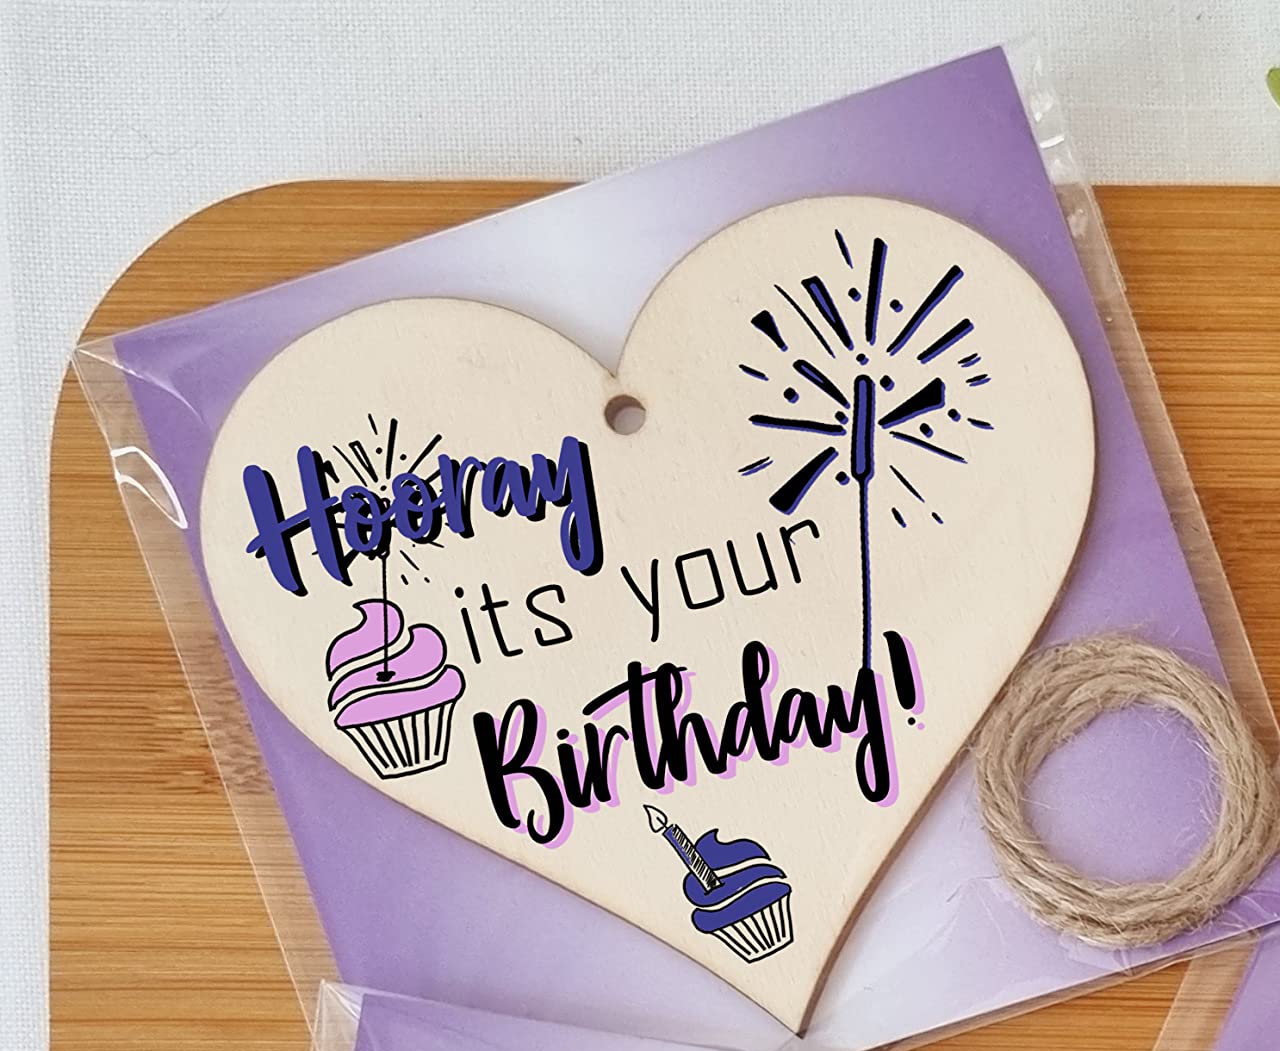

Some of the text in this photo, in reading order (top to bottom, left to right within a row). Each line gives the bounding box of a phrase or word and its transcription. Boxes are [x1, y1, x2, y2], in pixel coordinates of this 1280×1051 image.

[244, 437, 603, 596] Hooray
[455, 520, 820, 664] its your
[473, 631, 925, 848] Birthday!
